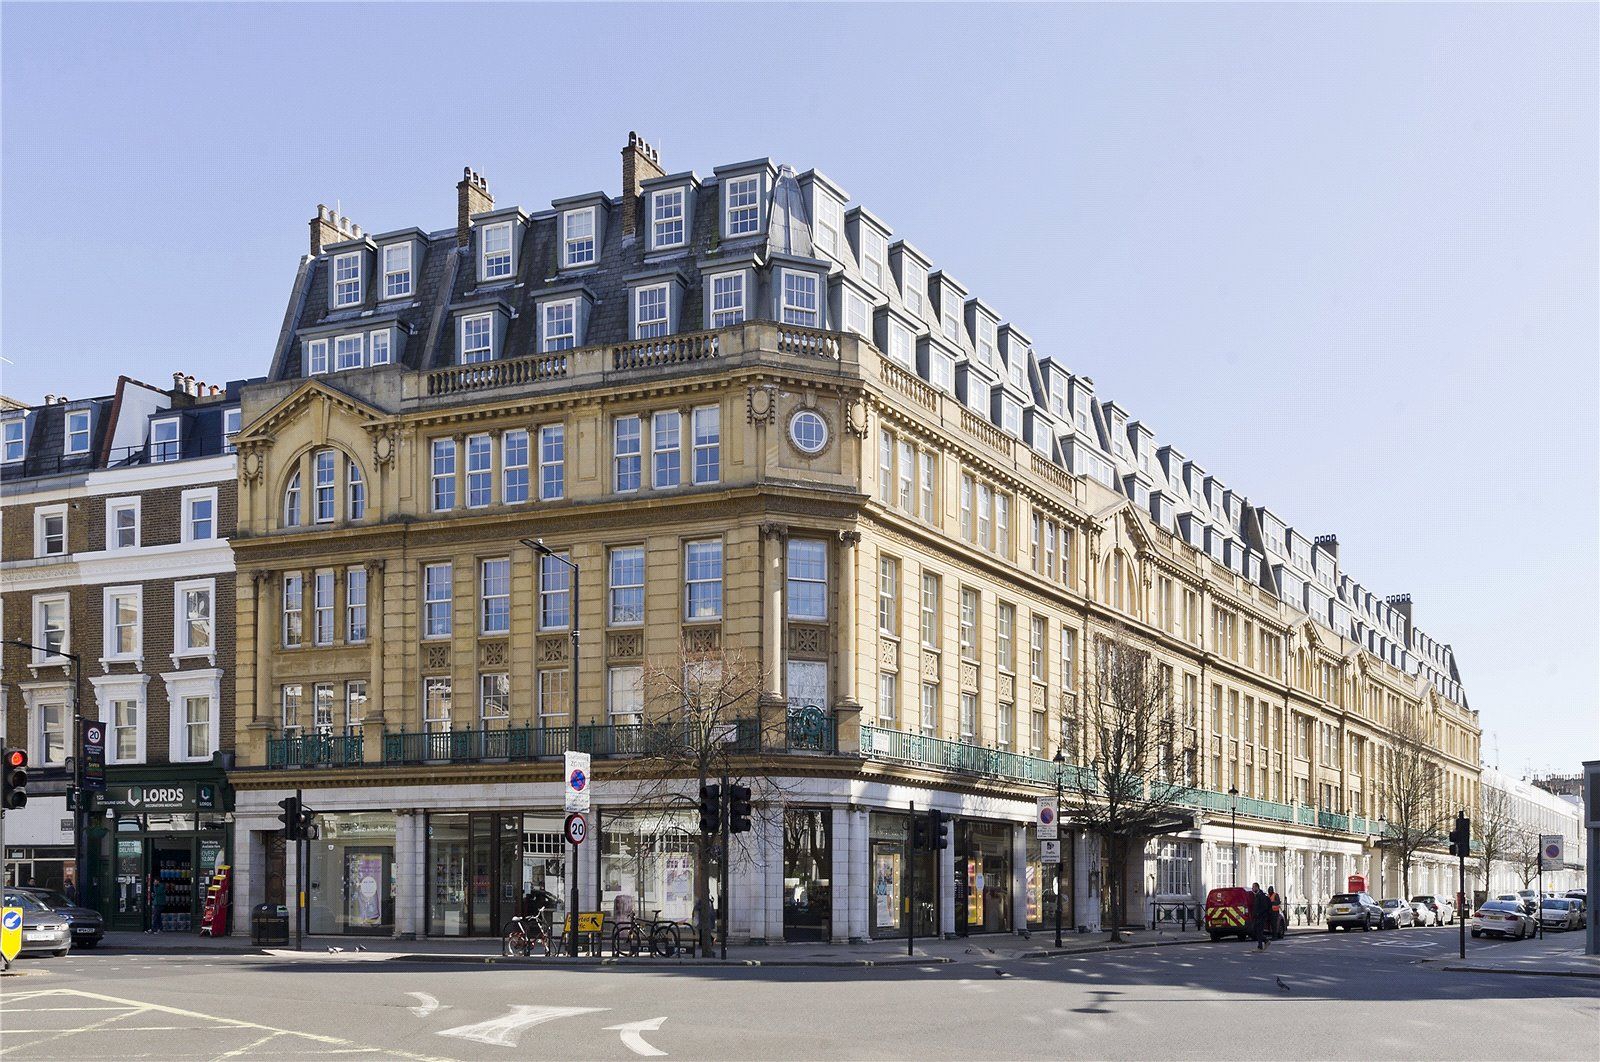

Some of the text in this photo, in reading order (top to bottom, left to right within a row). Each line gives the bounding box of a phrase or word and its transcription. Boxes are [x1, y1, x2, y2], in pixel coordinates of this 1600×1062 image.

[89, 731, 99, 740] 20
[143, 788, 184, 802] LORDS
[572, 823, 584, 836] 20
